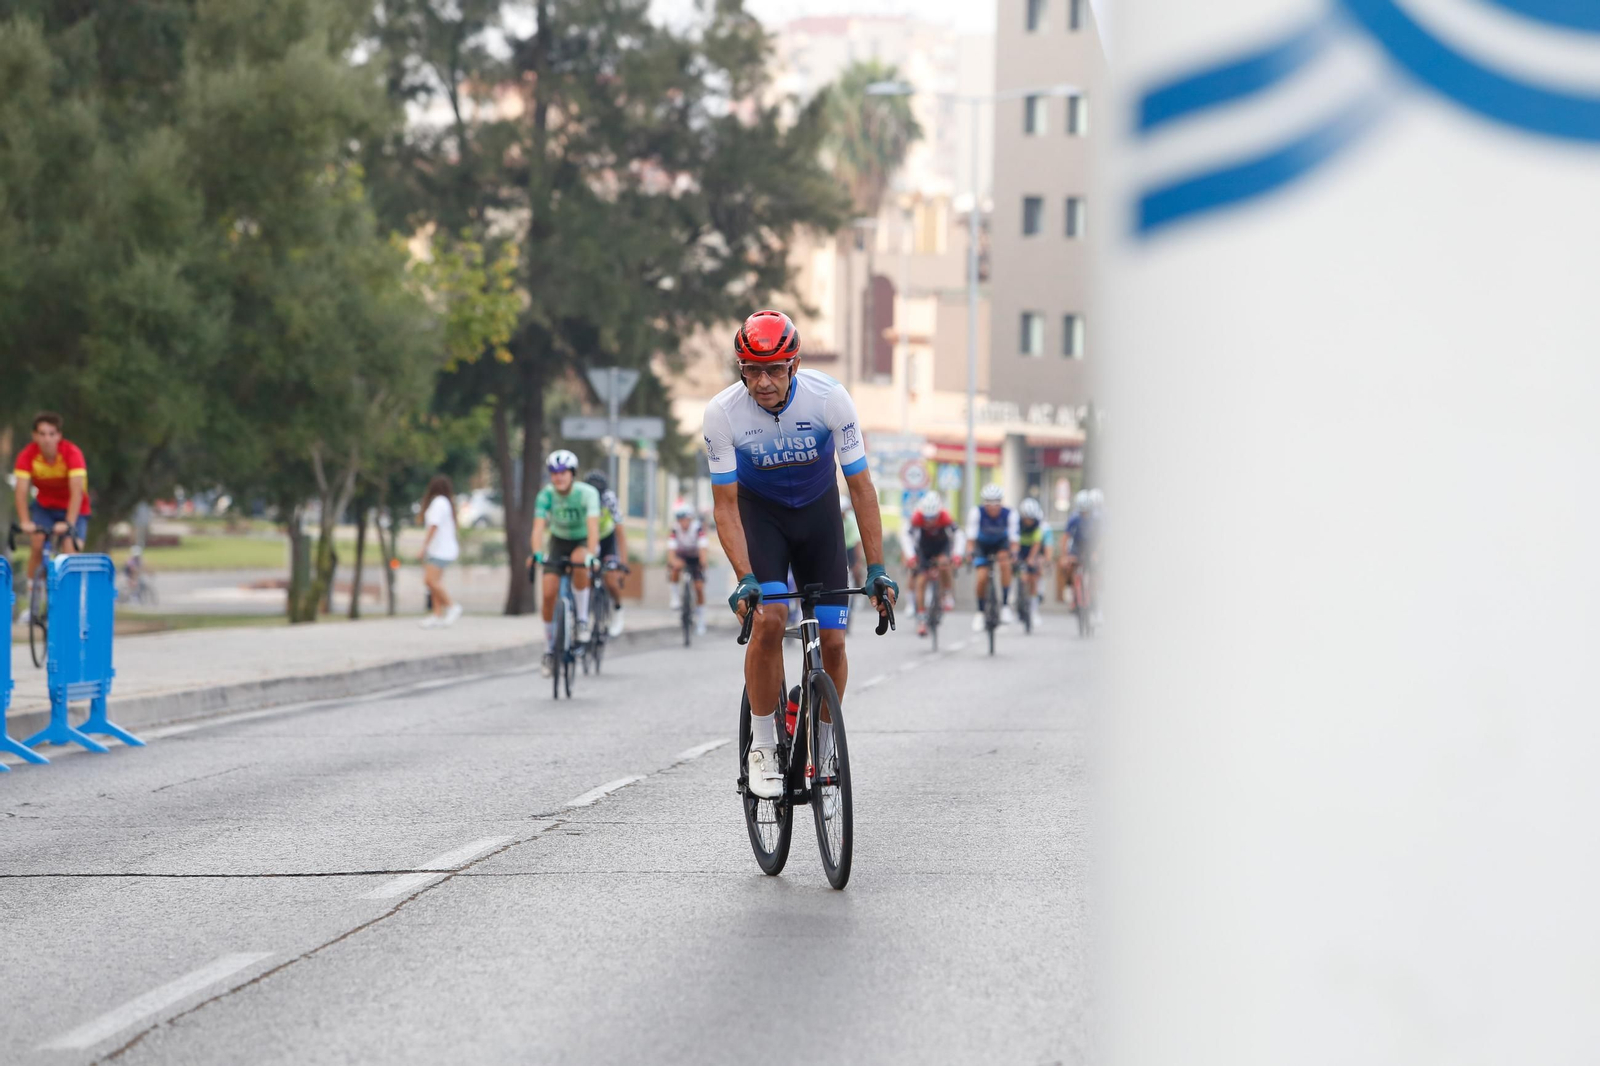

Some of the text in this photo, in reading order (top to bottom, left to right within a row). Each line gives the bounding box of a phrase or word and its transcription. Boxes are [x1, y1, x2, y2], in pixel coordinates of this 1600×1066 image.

[750, 436, 817, 455] EL VISO
[762, 448, 819, 467] ALCOR
